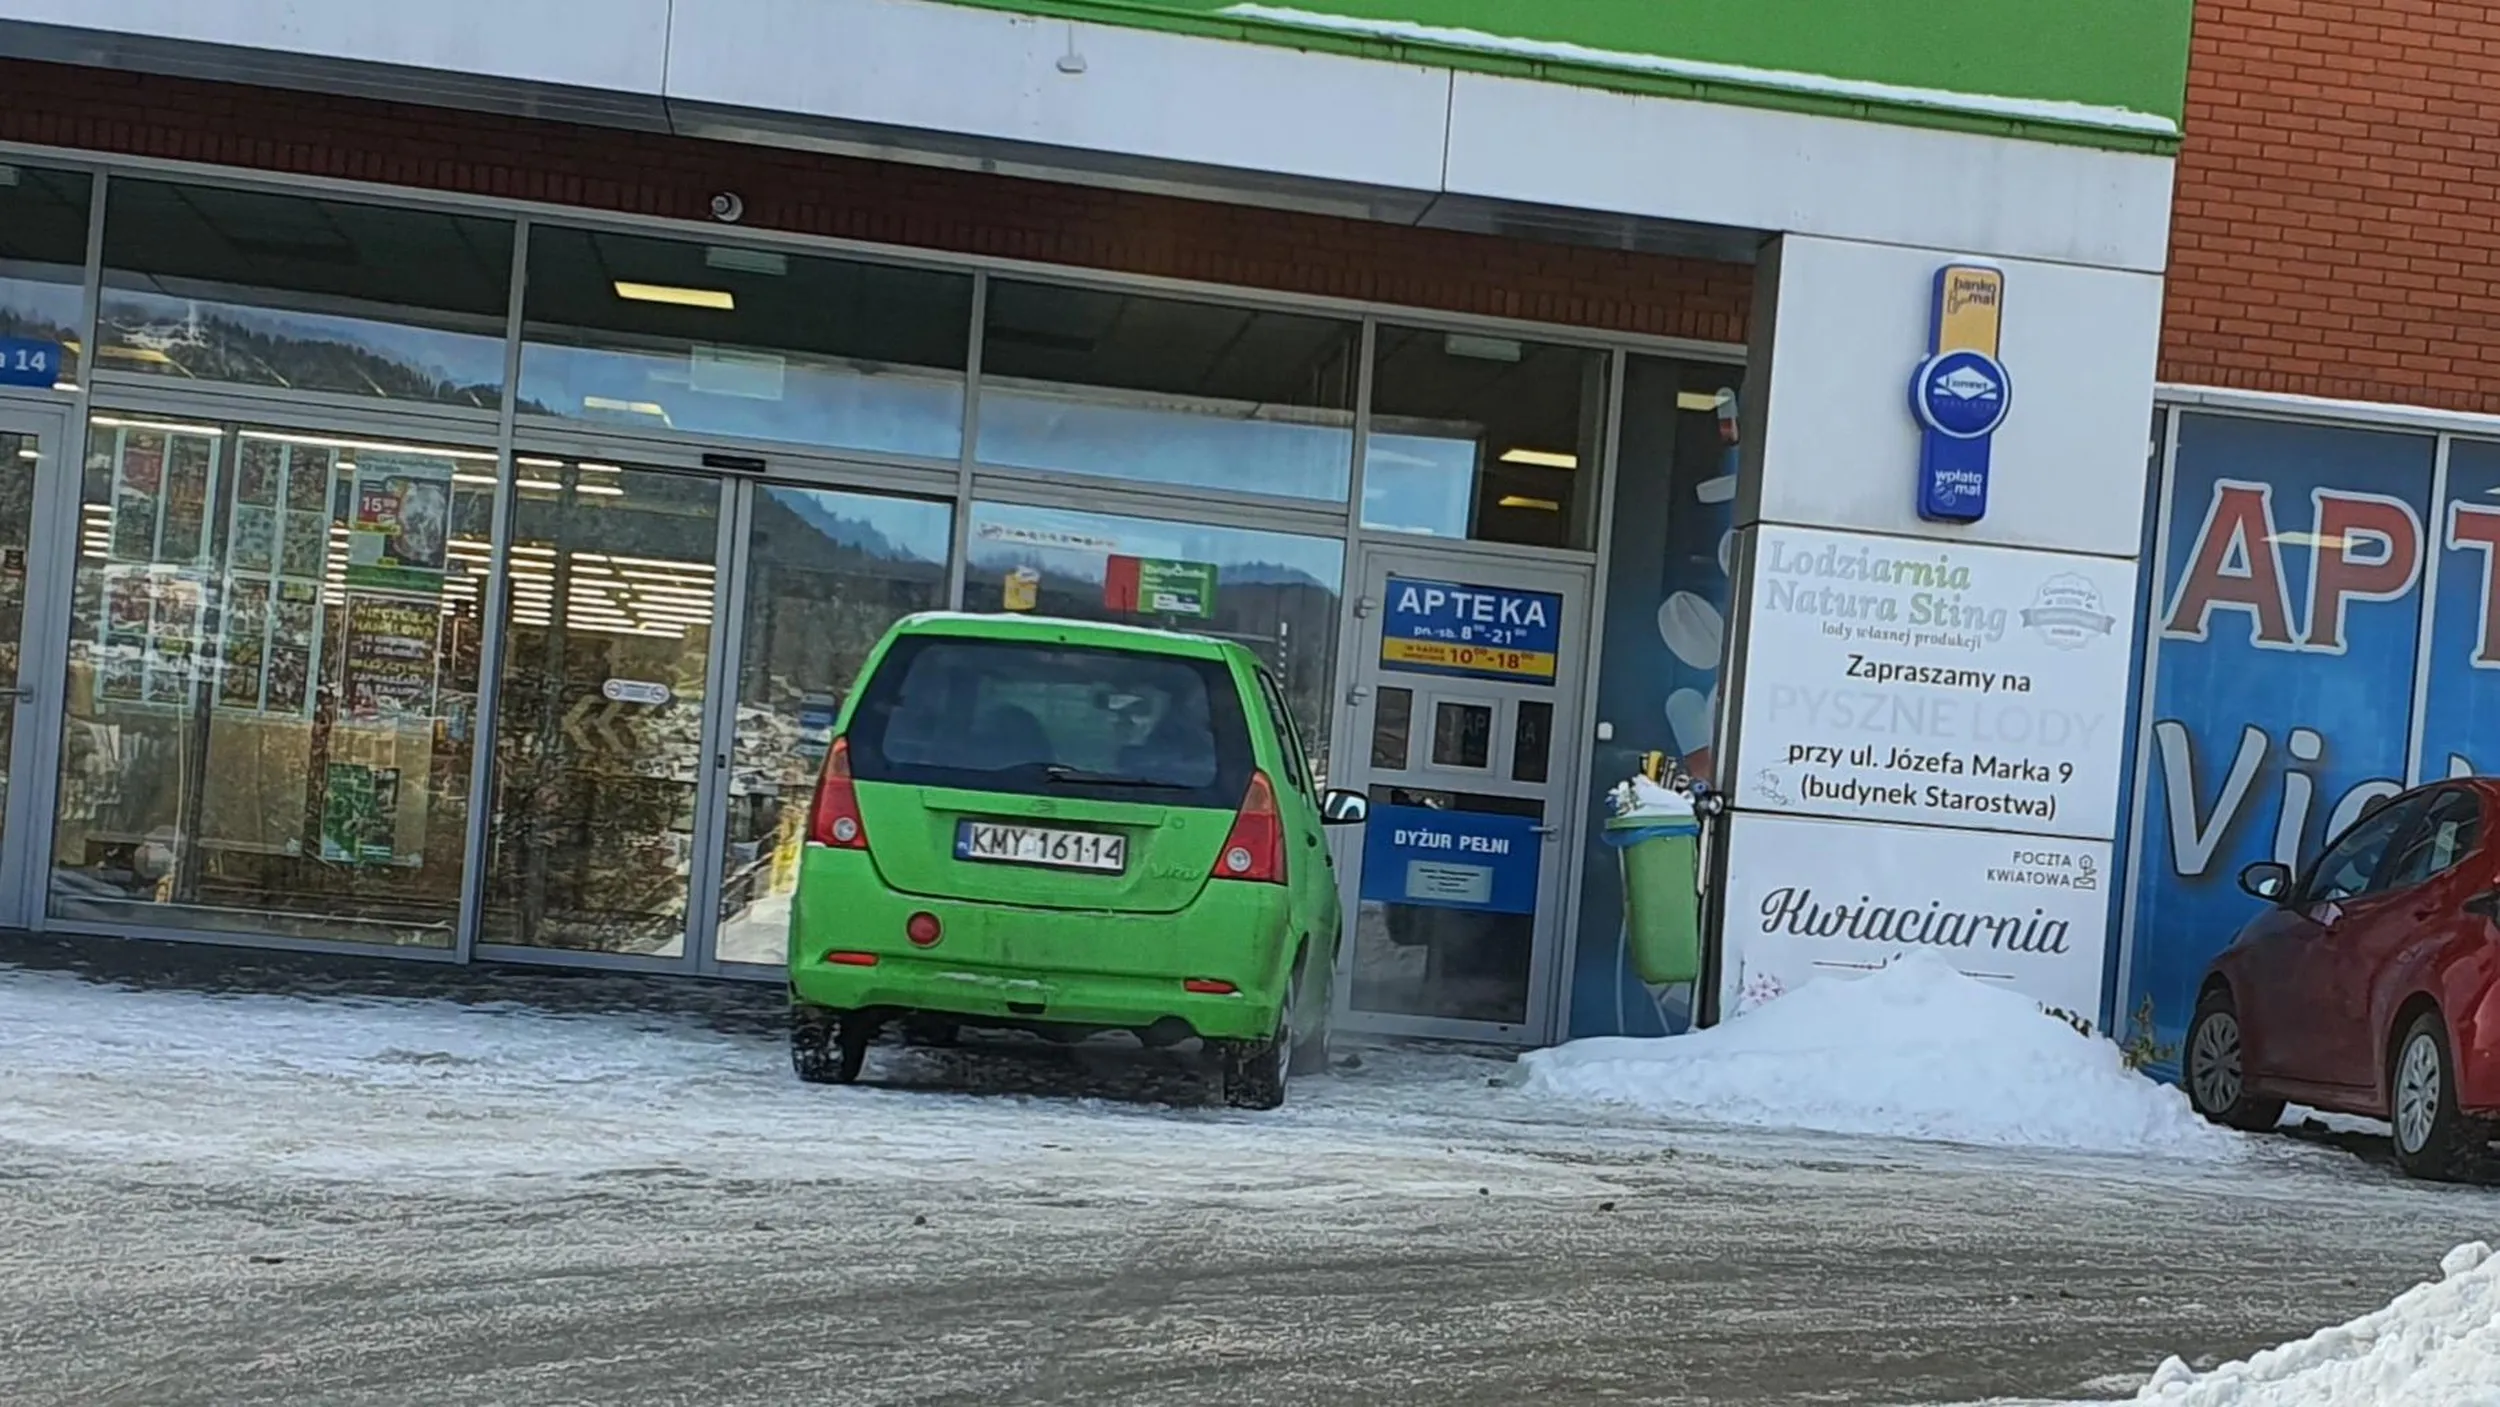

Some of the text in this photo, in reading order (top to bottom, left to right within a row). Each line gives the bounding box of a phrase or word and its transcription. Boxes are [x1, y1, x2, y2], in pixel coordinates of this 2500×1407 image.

[15, 349, 46, 372] 14
[363, 496, 382, 512] 15
[1768, 541, 1971, 591] Lodziarnia
[1397, 586, 1547, 628] APTEKA
[1765, 578, 2008, 642] Natura Sting
[1821, 620, 1982, 650] lody własnej produkcji
[1846, 654, 2032, 693] Zapraszamy na
[1768, 682, 2105, 749] PYSZNE LODY
[1788, 743, 2073, 784] przy ul. Józefa Marka 9
[1800, 773, 2056, 821] (budynek Starostwa)
[972, 825, 1122, 865] KMY 16114
[1394, 828, 1510, 854] DYŻUR PEŁNI
[2012, 851, 2072, 867] POCZTA
[1987, 868, 2070, 886] KWIATOWA
[1761, 886, 2070, 955] Kwiaciarnia
